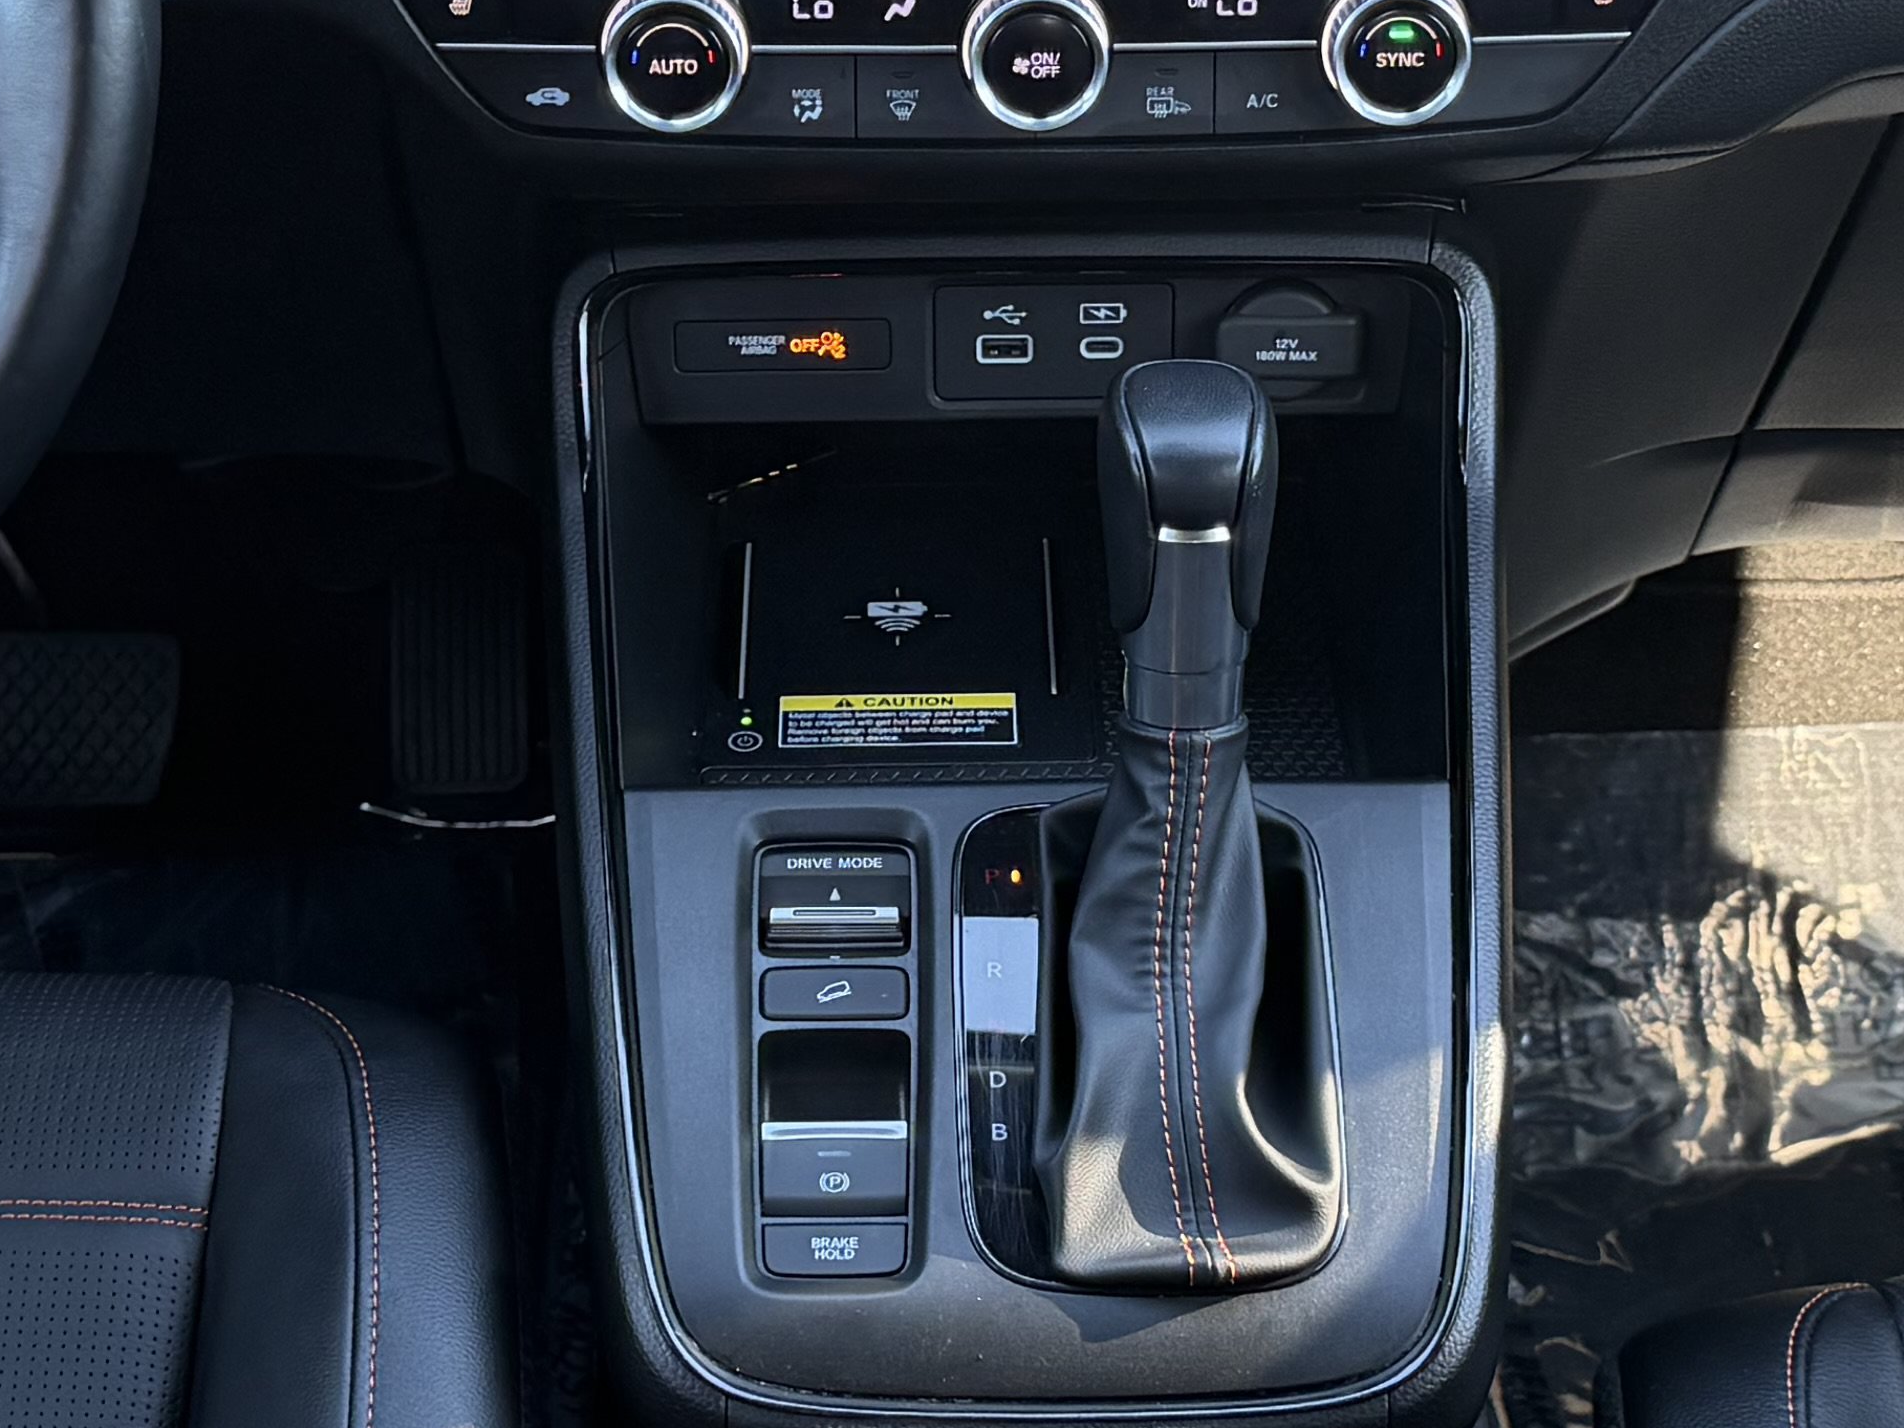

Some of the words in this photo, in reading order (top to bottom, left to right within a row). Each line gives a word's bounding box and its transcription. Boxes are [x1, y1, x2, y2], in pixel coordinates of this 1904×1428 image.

[1030, 51, 1061, 66] ON/
[1374, 51, 1426, 70] SYNC
[648, 57, 699, 76] AUTO
[1030, 65, 1061, 79] OFF
[791, 88, 824, 101] MODE
[885, 88, 920, 101] FRONT
[1146, 86, 1175, 97] REAR
[1246, 93, 1279, 109] A/C
[728, 335, 786, 346] PASSENGER
[789, 338, 820, 353] OFF
[1275, 338, 1299, 349] 12V
[741, 345, 777, 356] AIRBAG
[1255, 351, 1287, 361] 180W
[1289, 351, 1318, 361] MAX
[863, 696, 954, 708] CAUTION
[854, 710, 897, 719] between
[899, 710, 932, 719] charge
[934, 709, 954, 719] pad
[955, 709, 974, 717] and
[976, 708, 1009, 717] device
[815, 719, 855, 728] charged
[831, 727, 865, 736] foreign
[904, 726, 927, 734] from
[929, 726, 964, 734] charge
[965, 726, 986, 735] pad
[787, 736, 819, 744] before
[821, 735, 864, 744] charging
[787, 857, 832, 870] DRIVE
[838, 856, 883, 869] MODE
[985, 868, 1000, 885] P
[987, 961, 1002, 979] R
[990, 1071, 1007, 1088] D
[992, 1124, 1008, 1141] B
[811, 1236, 859, 1250] BRAKE
[814, 1248, 855, 1260] HOLD
